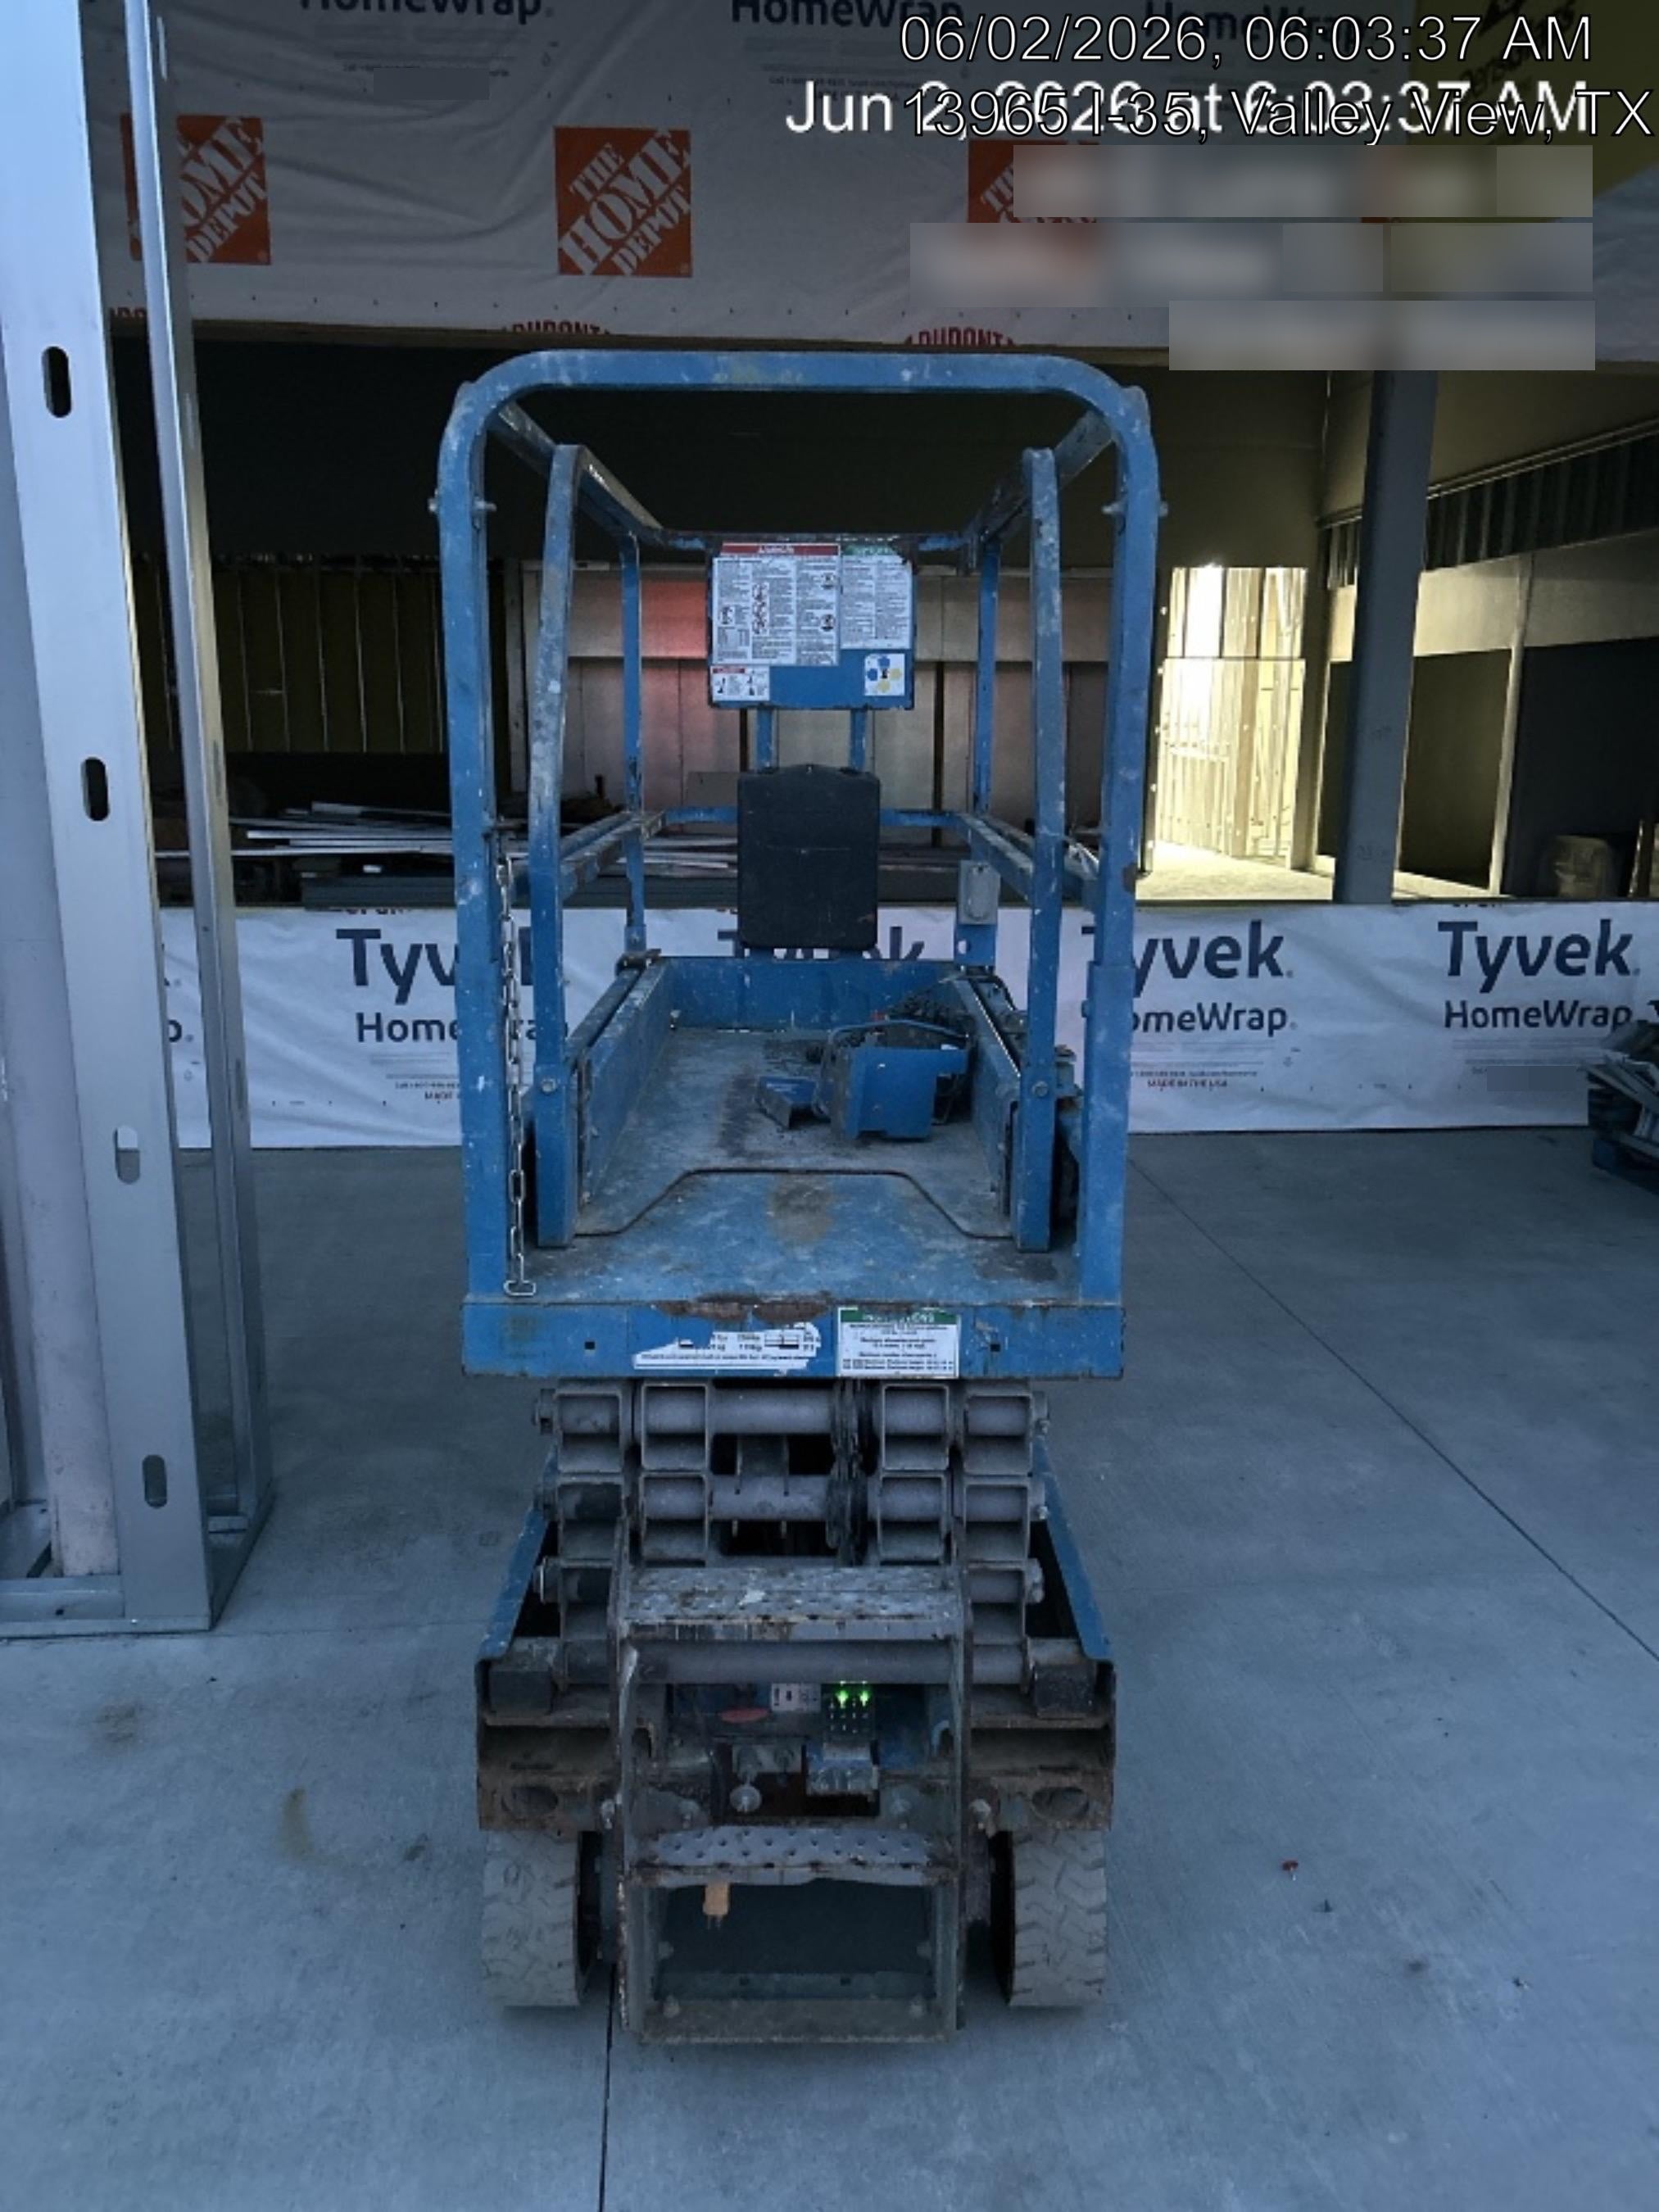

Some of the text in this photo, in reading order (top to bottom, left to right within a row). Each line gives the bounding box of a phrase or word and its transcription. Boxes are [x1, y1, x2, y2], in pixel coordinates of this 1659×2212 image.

[560, 131, 691, 276] HOME
[569, 143, 625, 202] THE
[611, 185, 691, 276] DEPOT
[336, 928, 534, 1005] Tyv
[1081, 919, 1284, 998] yvek
[1438, 918, 1633, 994] Tyvek
[1132, 1002, 1288, 1037] meWrap
[1444, 1000, 1633, 1032] HomeWrap
